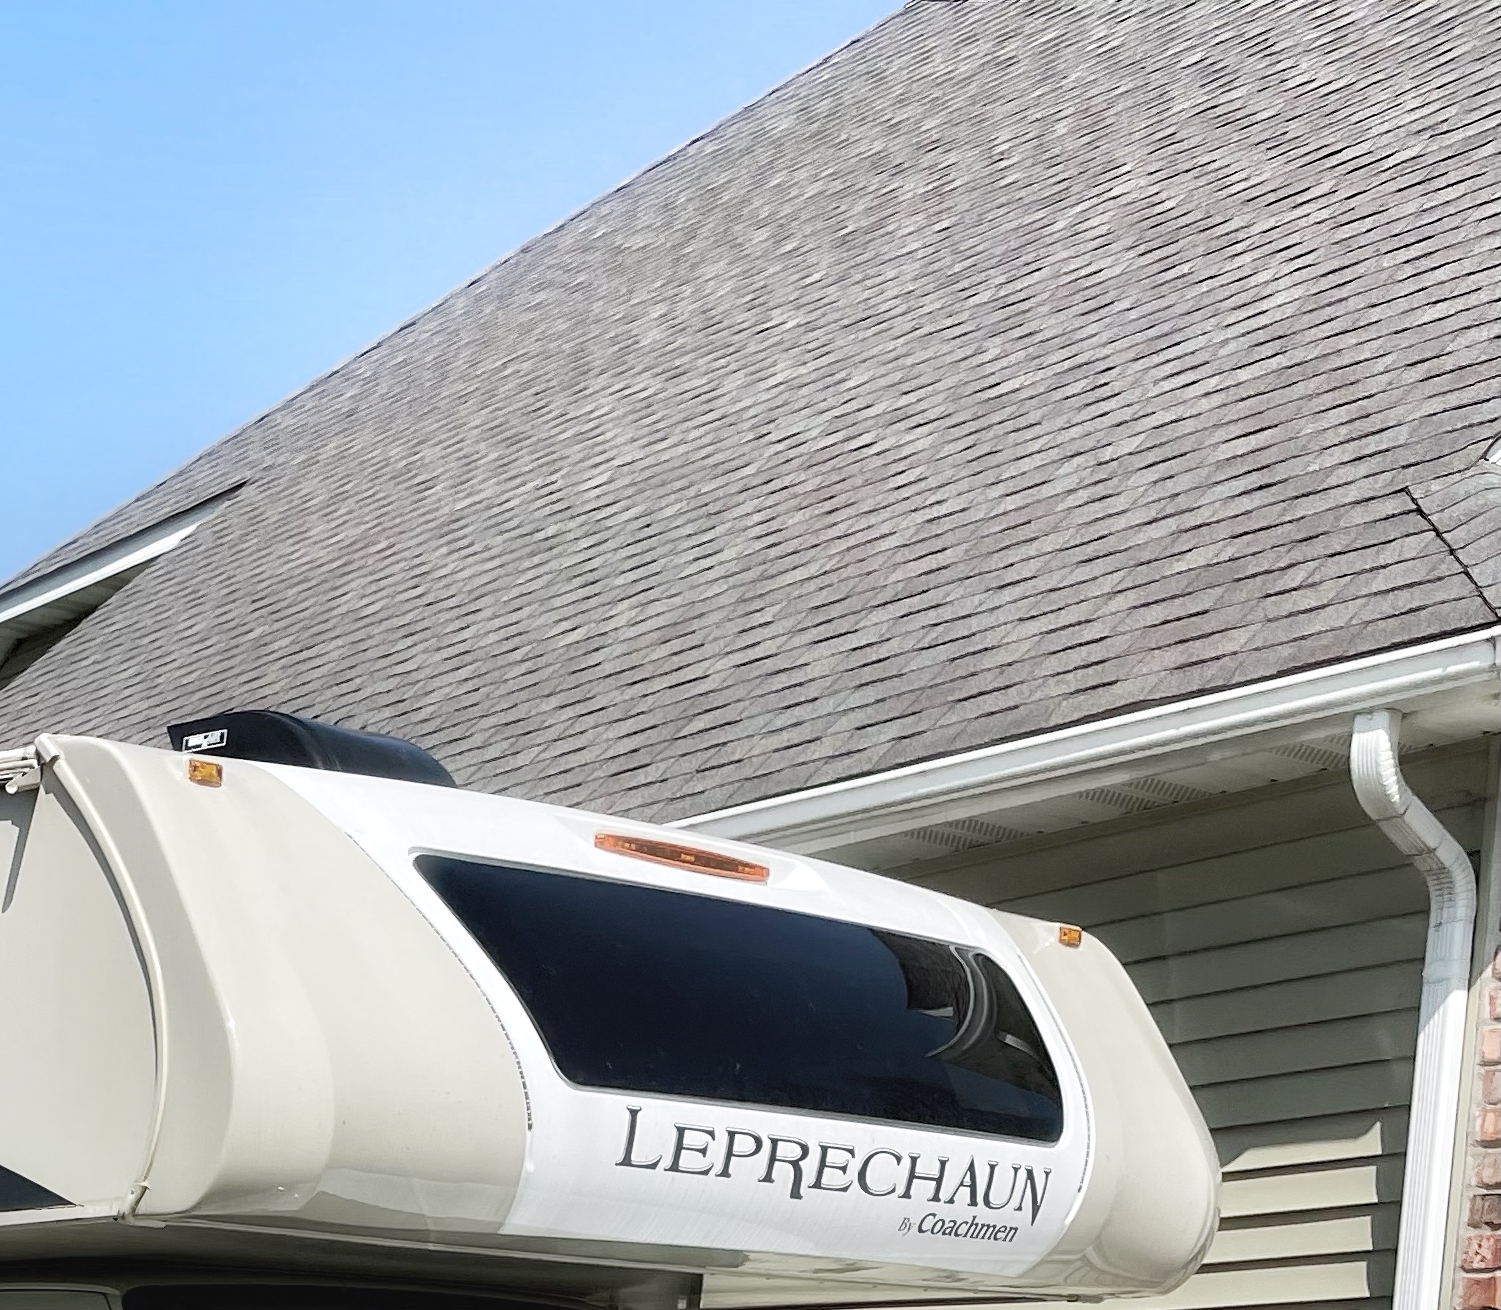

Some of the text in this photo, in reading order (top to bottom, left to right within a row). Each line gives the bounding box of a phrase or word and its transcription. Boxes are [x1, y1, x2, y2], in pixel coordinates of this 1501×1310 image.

[615, 1104, 1052, 1226] LEPRECHAUN
[898, 1212, 1018, 1243] By Coachmen
